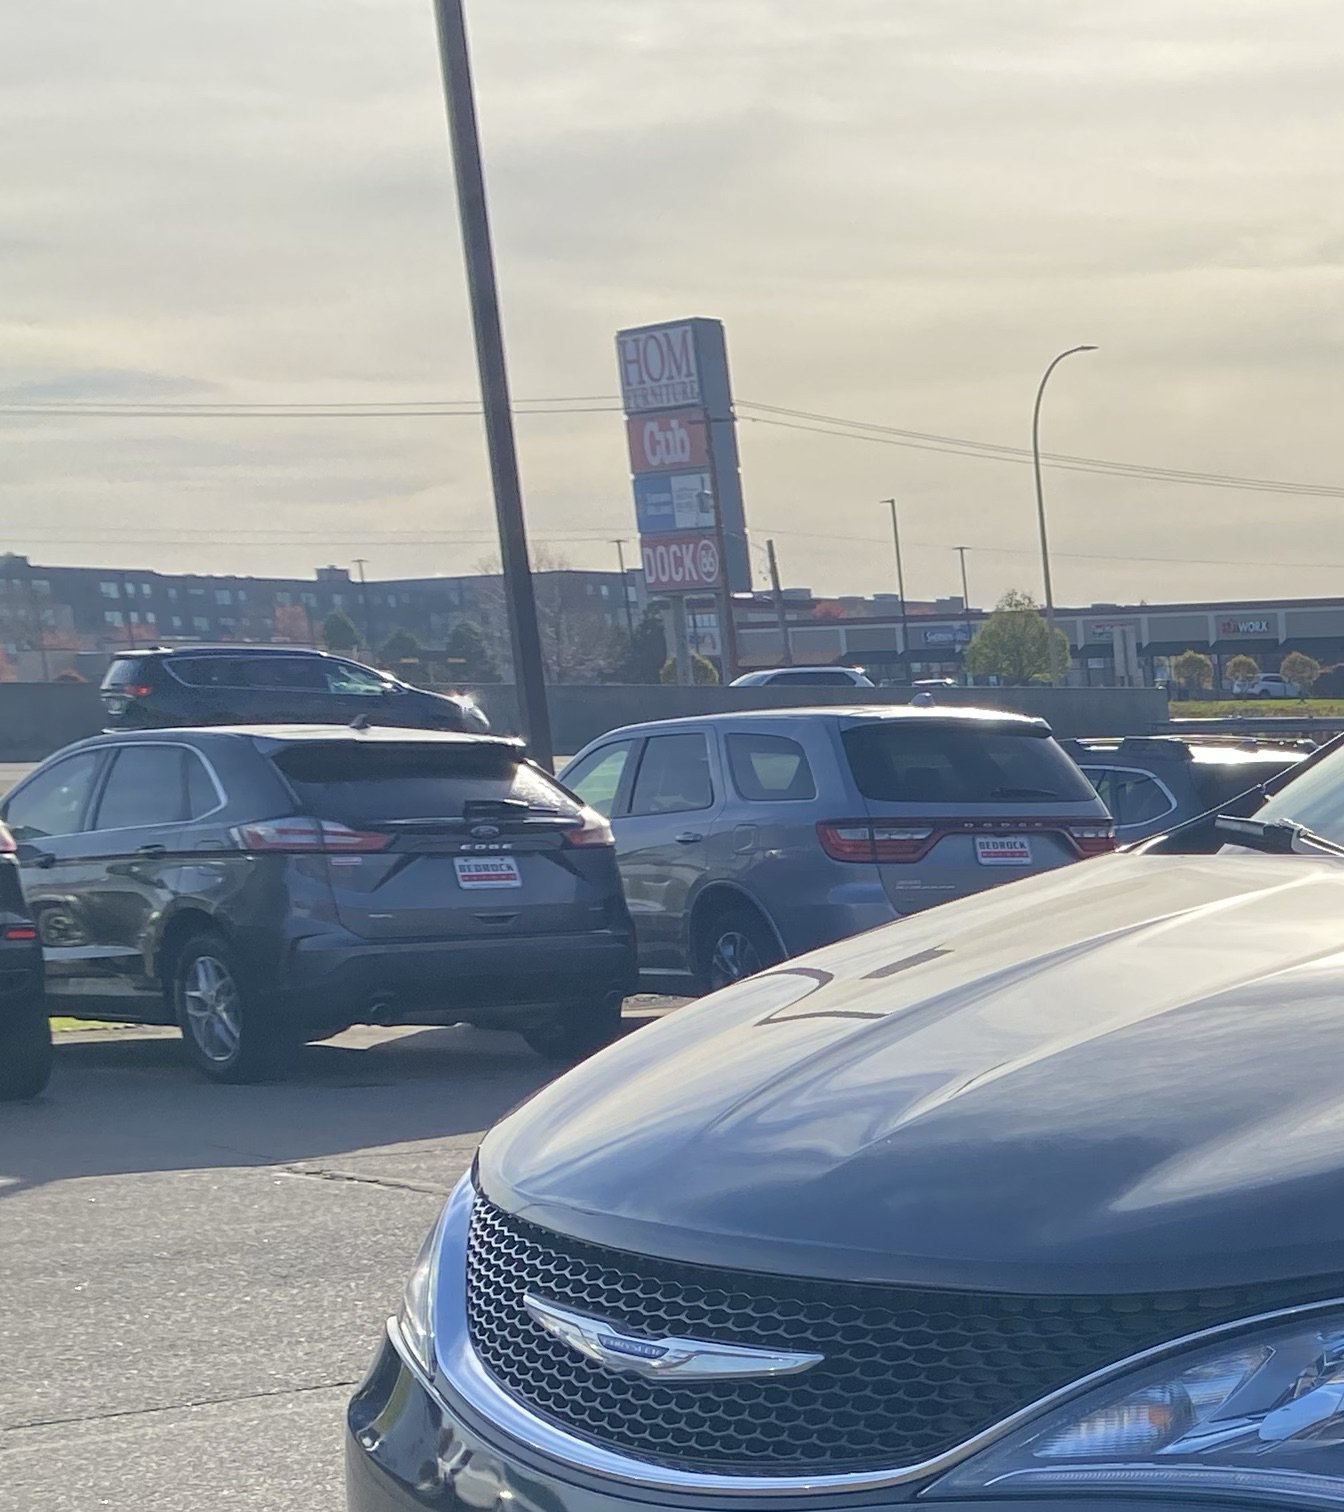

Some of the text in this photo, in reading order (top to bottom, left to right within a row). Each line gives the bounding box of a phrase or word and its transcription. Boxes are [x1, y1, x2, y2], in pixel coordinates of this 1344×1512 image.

[618, 328, 694, 386] HOM
[643, 419, 690, 466] Cub
[643, 543, 698, 583] DOCK
[979, 841, 1027, 850] BEDROCK
[458, 863, 514, 873] BEDROCK
